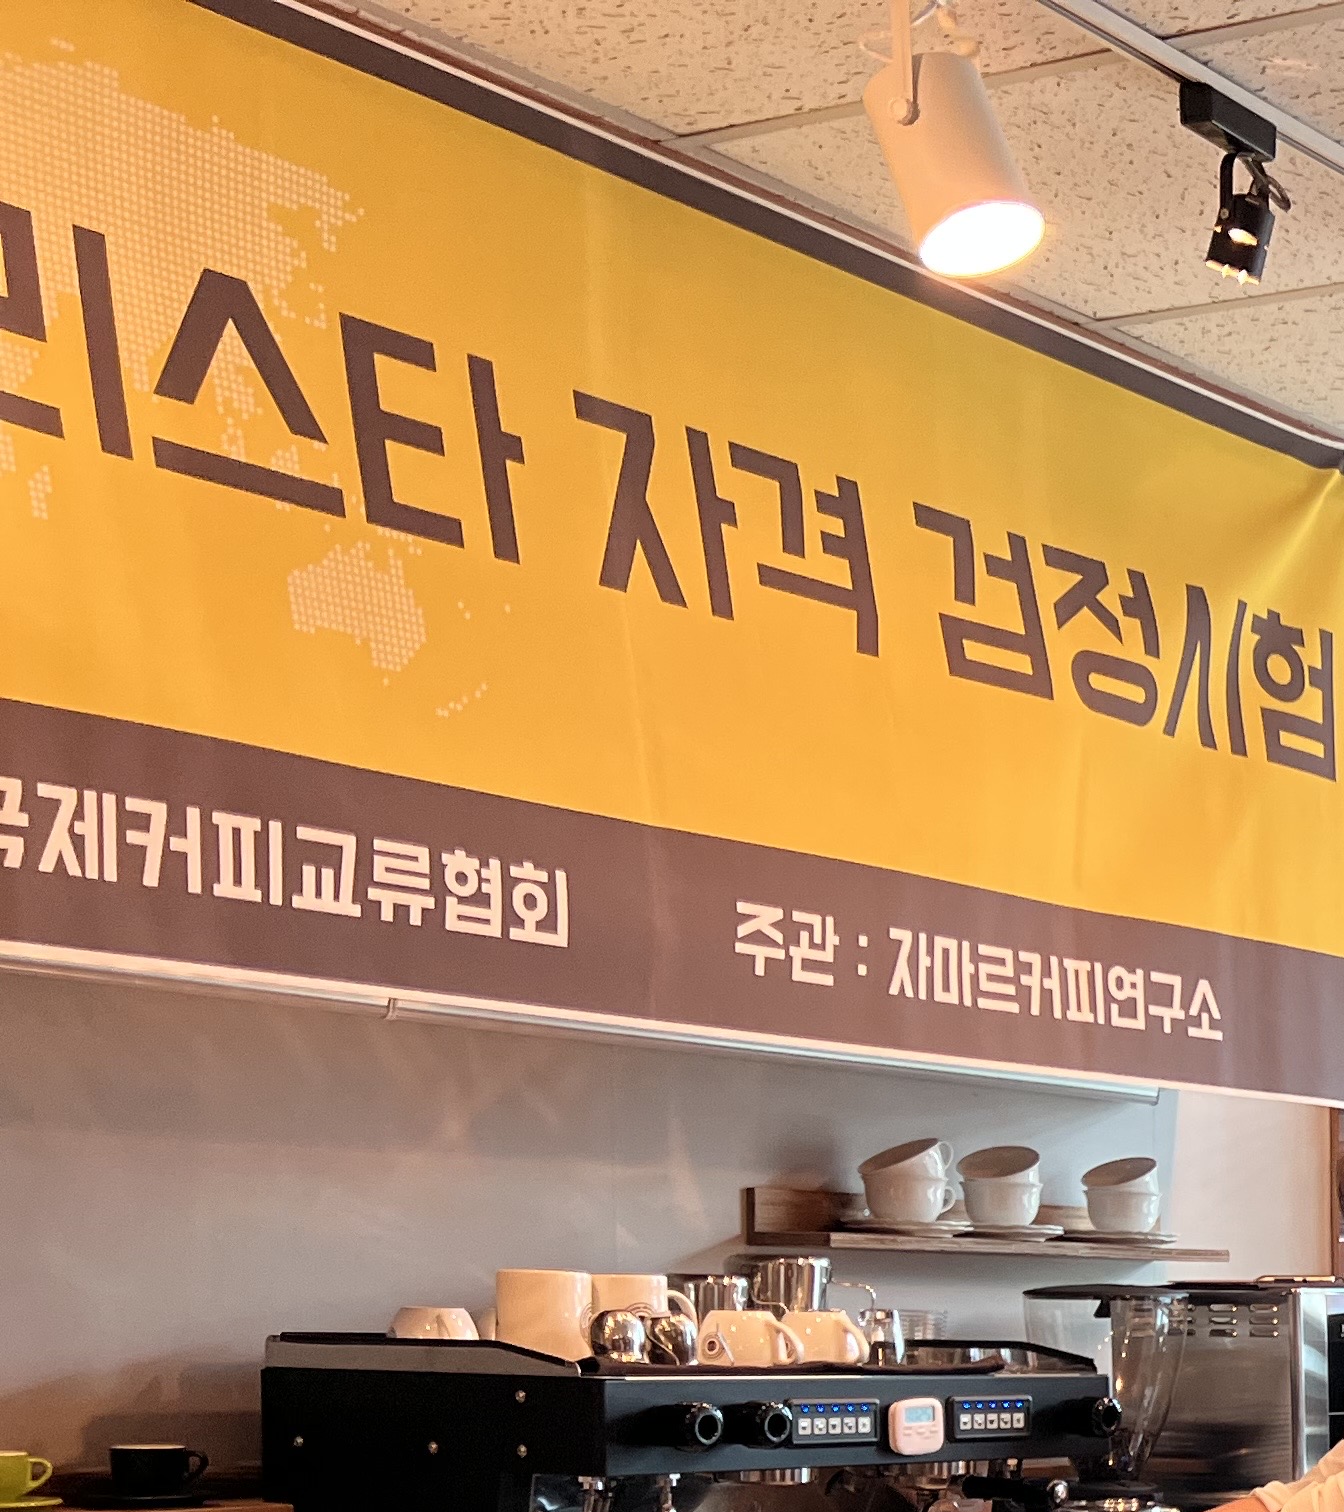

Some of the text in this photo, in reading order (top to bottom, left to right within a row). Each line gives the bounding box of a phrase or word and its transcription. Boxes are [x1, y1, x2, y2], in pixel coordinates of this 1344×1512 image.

[573, 389, 879, 658] 자격
[912, 501, 1337, 782] 검정시험
[734, 901, 839, 987] 주관
[888, 927, 1224, 1041] 자마르커피연구소
